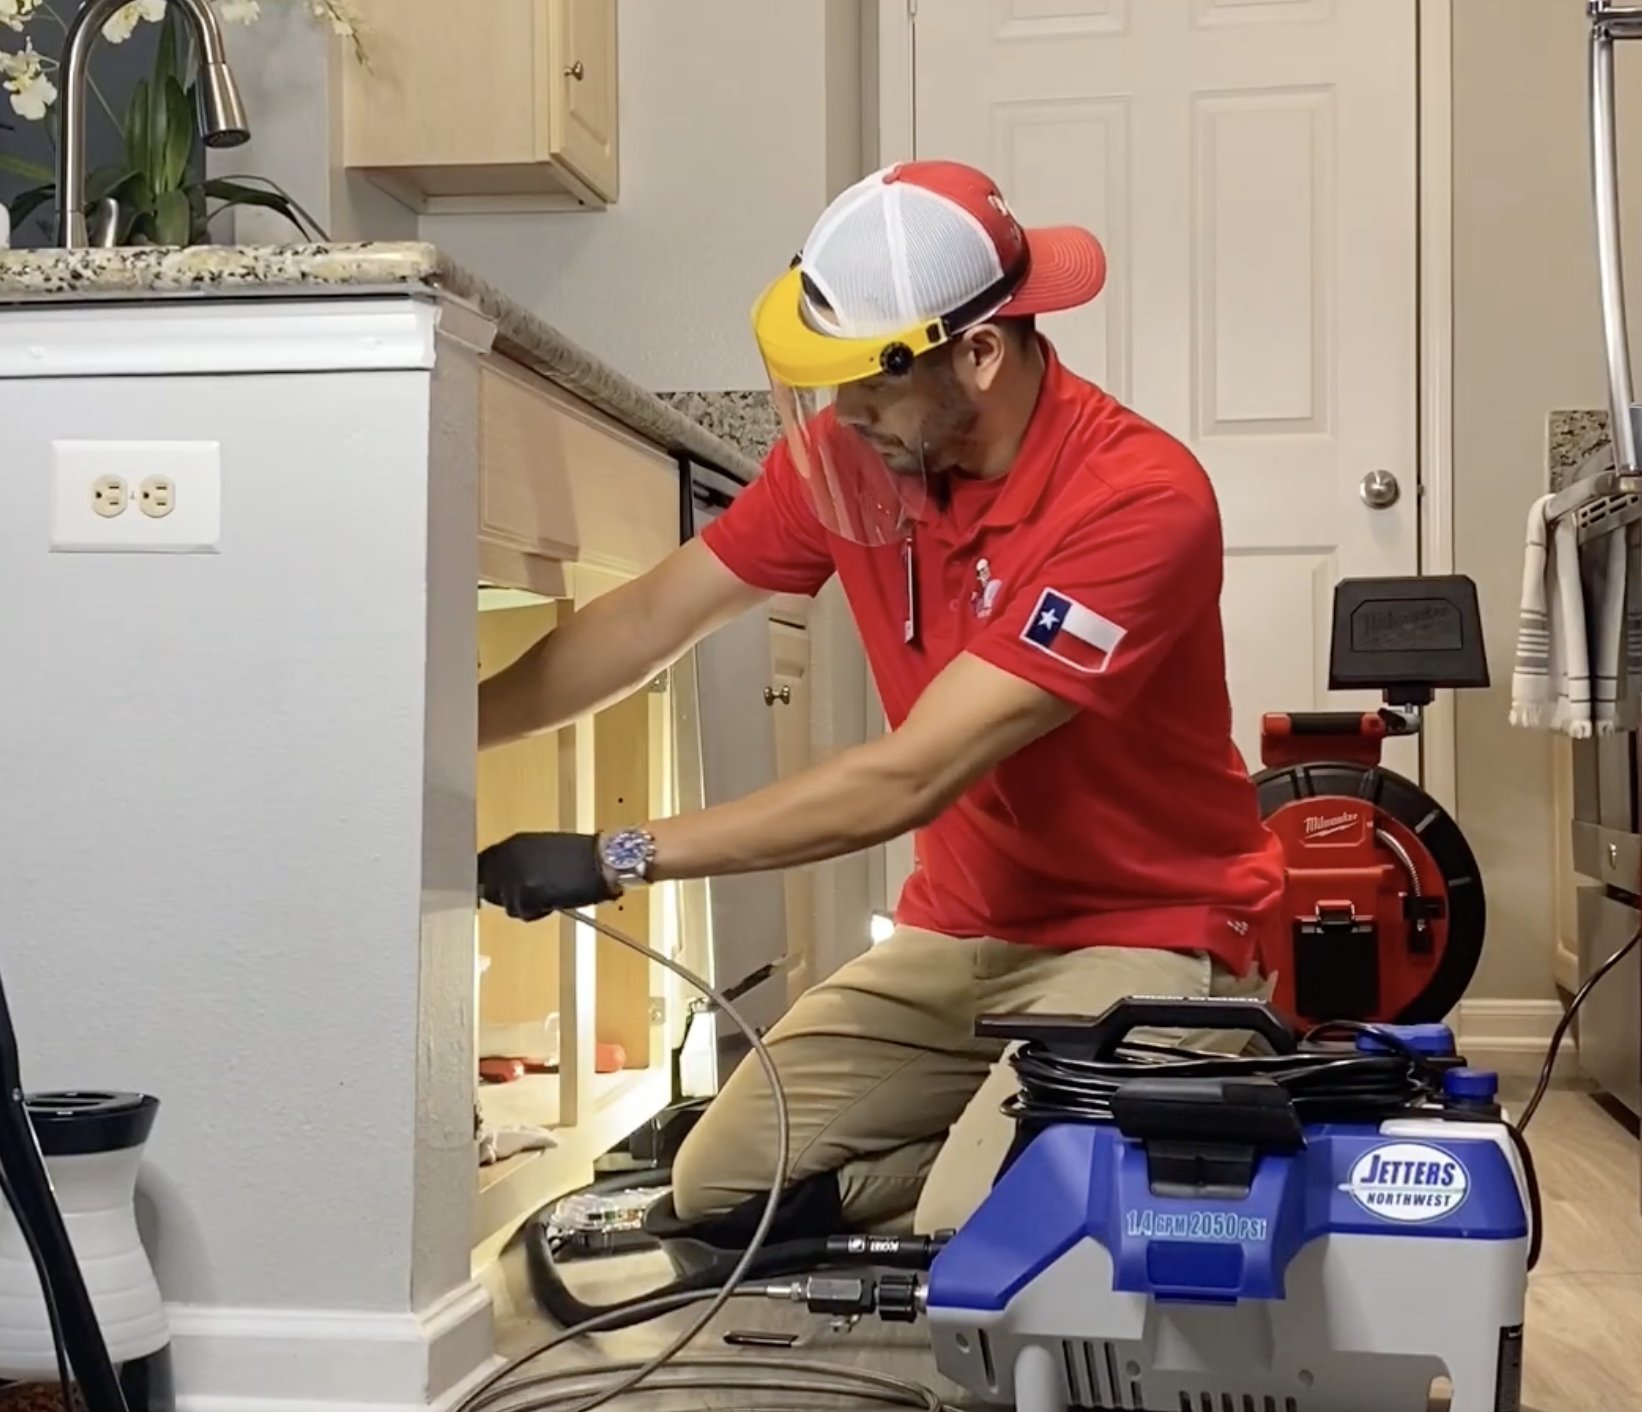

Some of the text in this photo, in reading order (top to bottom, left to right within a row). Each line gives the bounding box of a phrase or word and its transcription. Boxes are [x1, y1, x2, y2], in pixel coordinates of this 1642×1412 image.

[1361, 1154, 1455, 1186] JETTERS
[1367, 1192, 1452, 1206] NORTHWEST
[1126, 1210, 1153, 1236] 1.4
[1155, 1214, 1188, 1237] GPM
[1189, 1211, 1238, 1239] 2050
